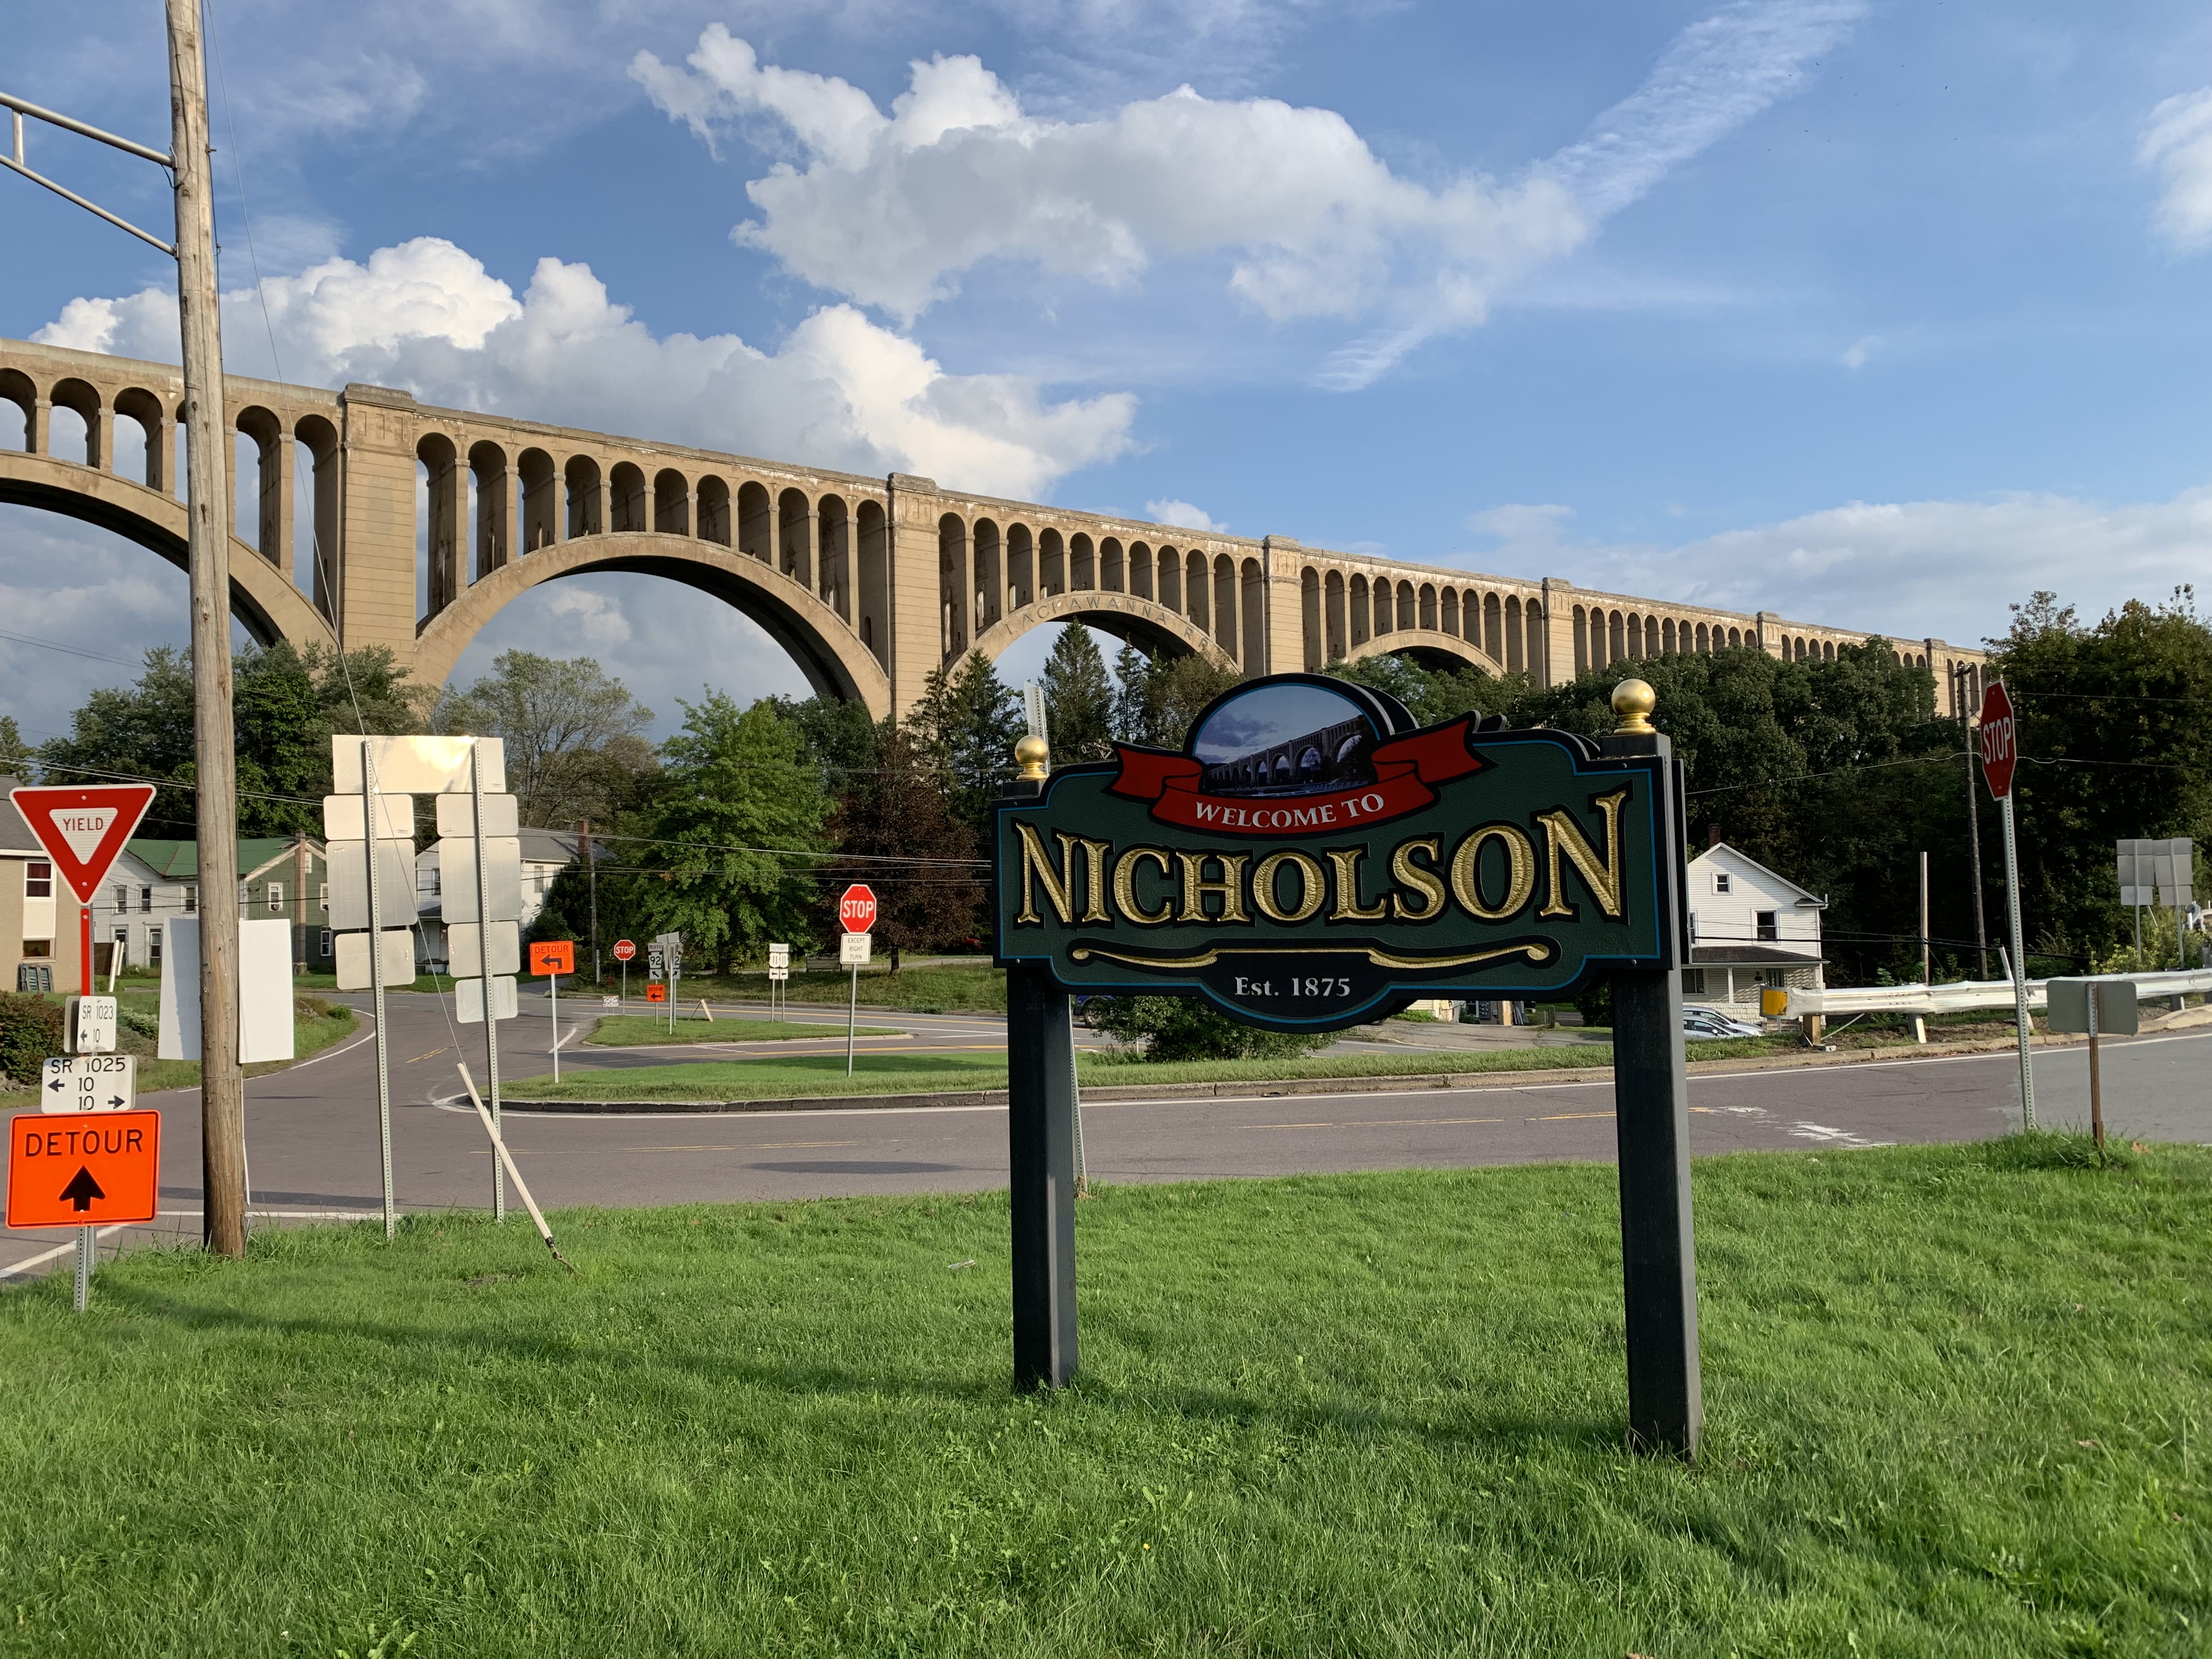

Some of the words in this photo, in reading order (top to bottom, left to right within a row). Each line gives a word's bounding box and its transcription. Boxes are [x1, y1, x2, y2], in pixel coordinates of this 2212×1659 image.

[1983, 716, 2011, 764] STOP
[1196, 801, 1336, 827] WELCOME
[1341, 793, 1384, 818] TO
[63, 817, 103, 831] YIELD
[1015, 790, 1626, 924] NICHOLSON
[843, 900, 874, 918] STOP
[534, 945, 568, 954] DETOUR
[616, 946, 634, 954] STOP
[650, 956, 661, 965] 92
[773, 956, 777, 964] 11
[782, 956, 786, 964] 11
[1234, 977, 1279, 996] Est.
[1291, 977, 1351, 997] 1875
[82, 1005, 92, 1019] SR
[96, 1005, 114, 1020] 1023
[93, 1028, 100, 1043] 10
[51, 1059, 72, 1074] SR
[86, 1057, 126, 1073] 1025
[78, 1077, 94, 1092] 10
[78, 1096, 94, 1110] 10
[25, 1128, 143, 1157] DETOUR
